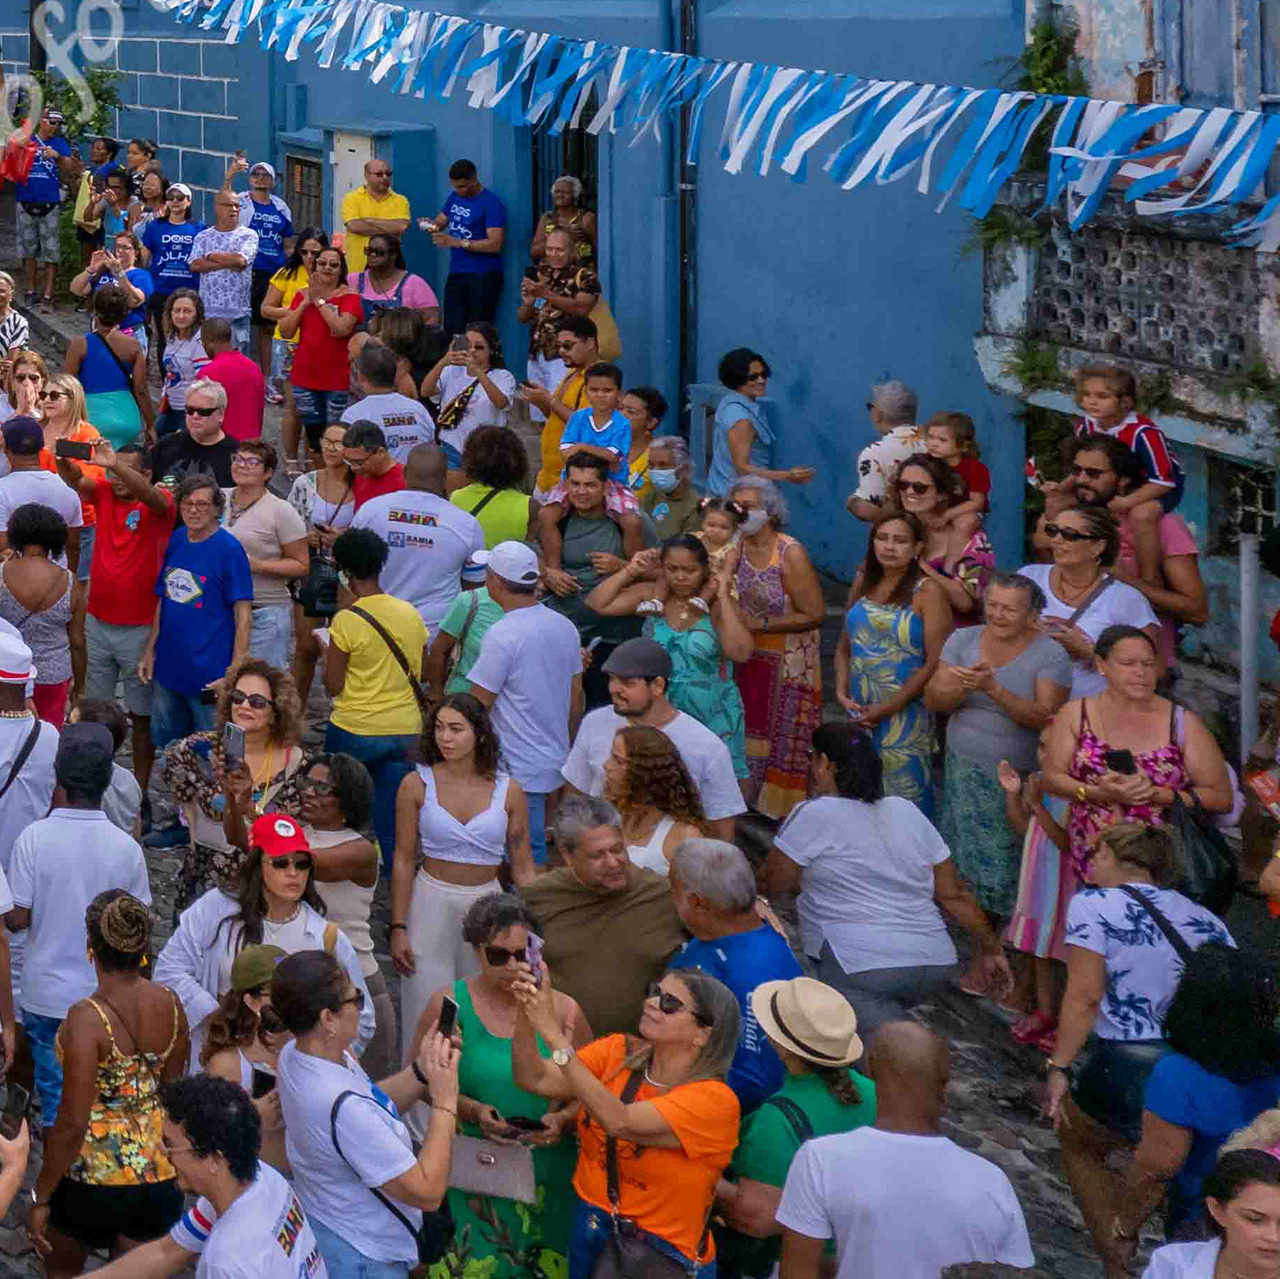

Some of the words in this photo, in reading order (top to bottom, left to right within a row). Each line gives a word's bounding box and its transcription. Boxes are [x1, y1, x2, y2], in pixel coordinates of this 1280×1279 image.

[253, 212, 282, 224] DOIS
[448, 221, 472, 239] ULHO
[161, 234, 193, 244] DOIS
[157, 251, 189, 266] JULH
